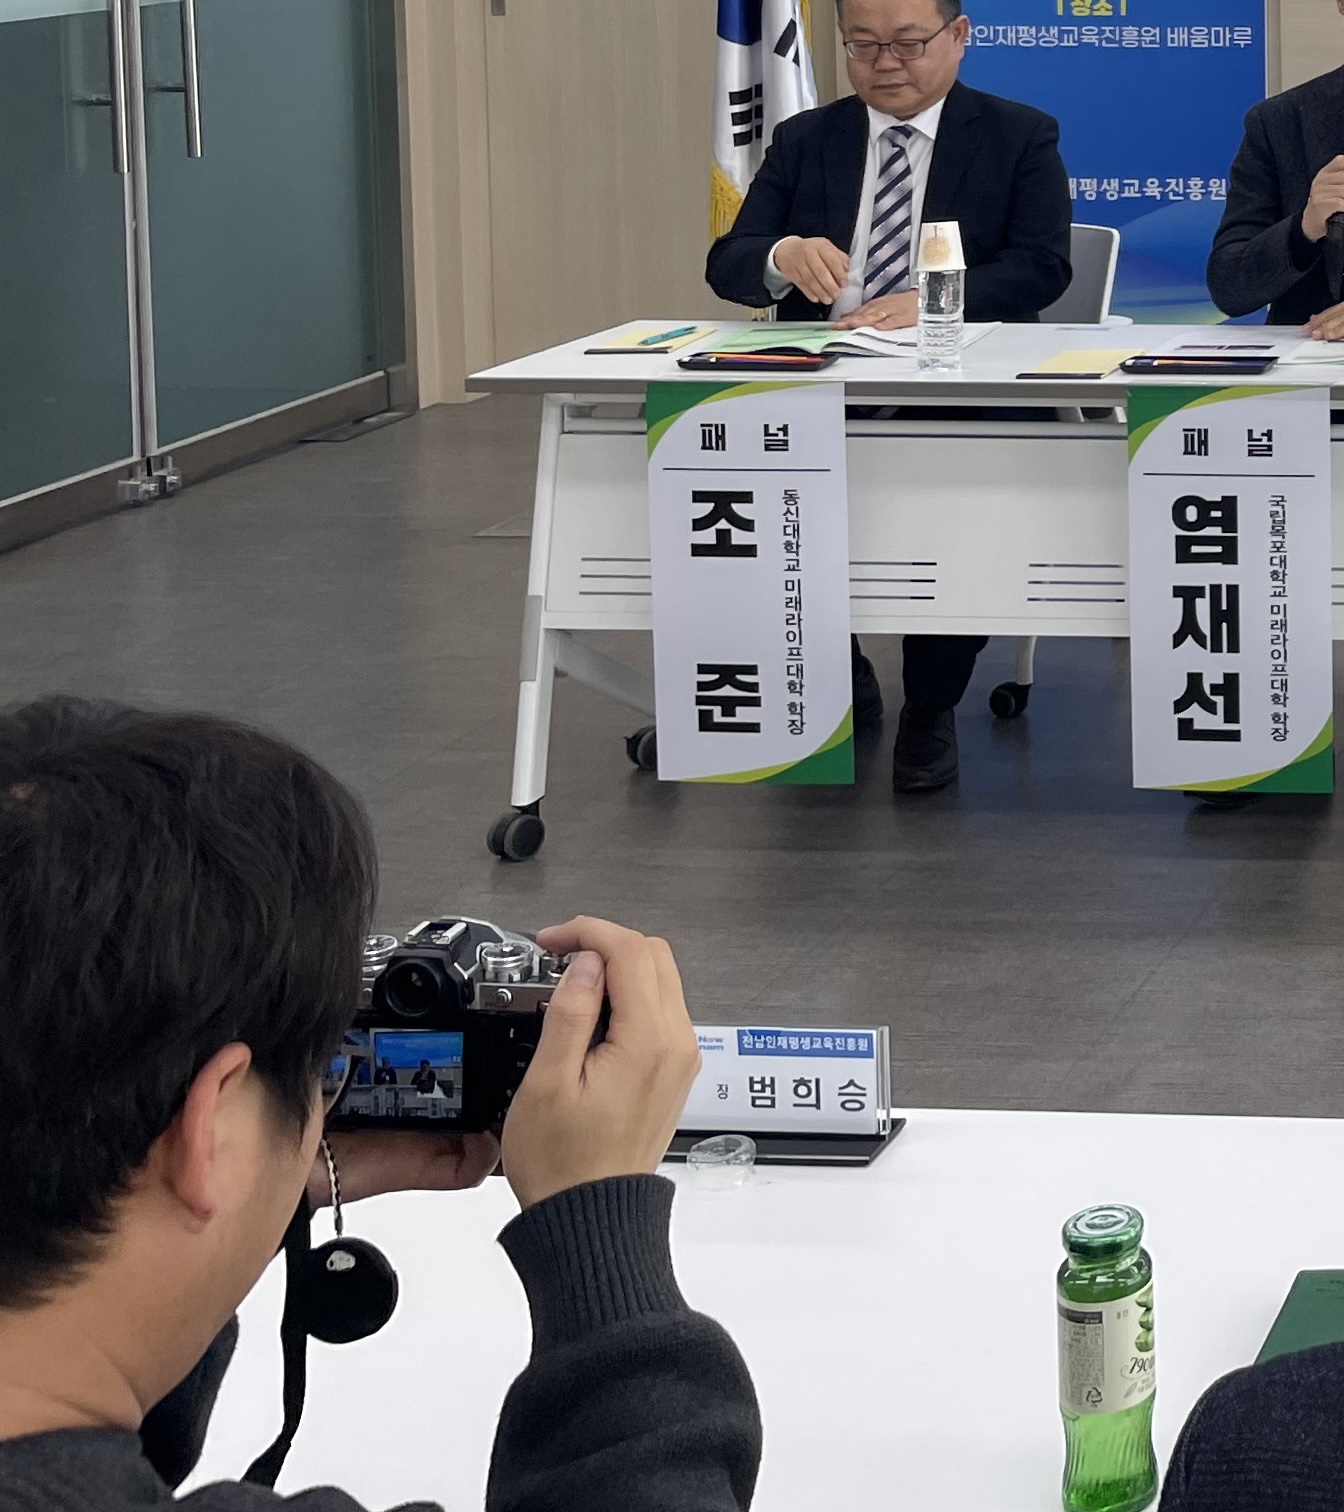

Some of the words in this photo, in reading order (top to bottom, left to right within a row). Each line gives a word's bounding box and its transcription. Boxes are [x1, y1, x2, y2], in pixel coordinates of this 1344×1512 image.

[1167, 26, 1253, 48] 배움마루
[782, 489, 802, 573] 동신대학교
[1268, 494, 1289, 598] 국립목포대학교
[784, 579, 804, 696] 미래라이프대학
[1171, 494, 1242, 742] 염재선
[1269, 603, 1289, 708] 미래라이프대학
[786, 701, 805, 736] 학장
[1270, 712, 1289, 743] 학장
[742, 1034, 868, 1051] 전남인재평생교육진흥원
[716, 1083, 729, 1100] 장
